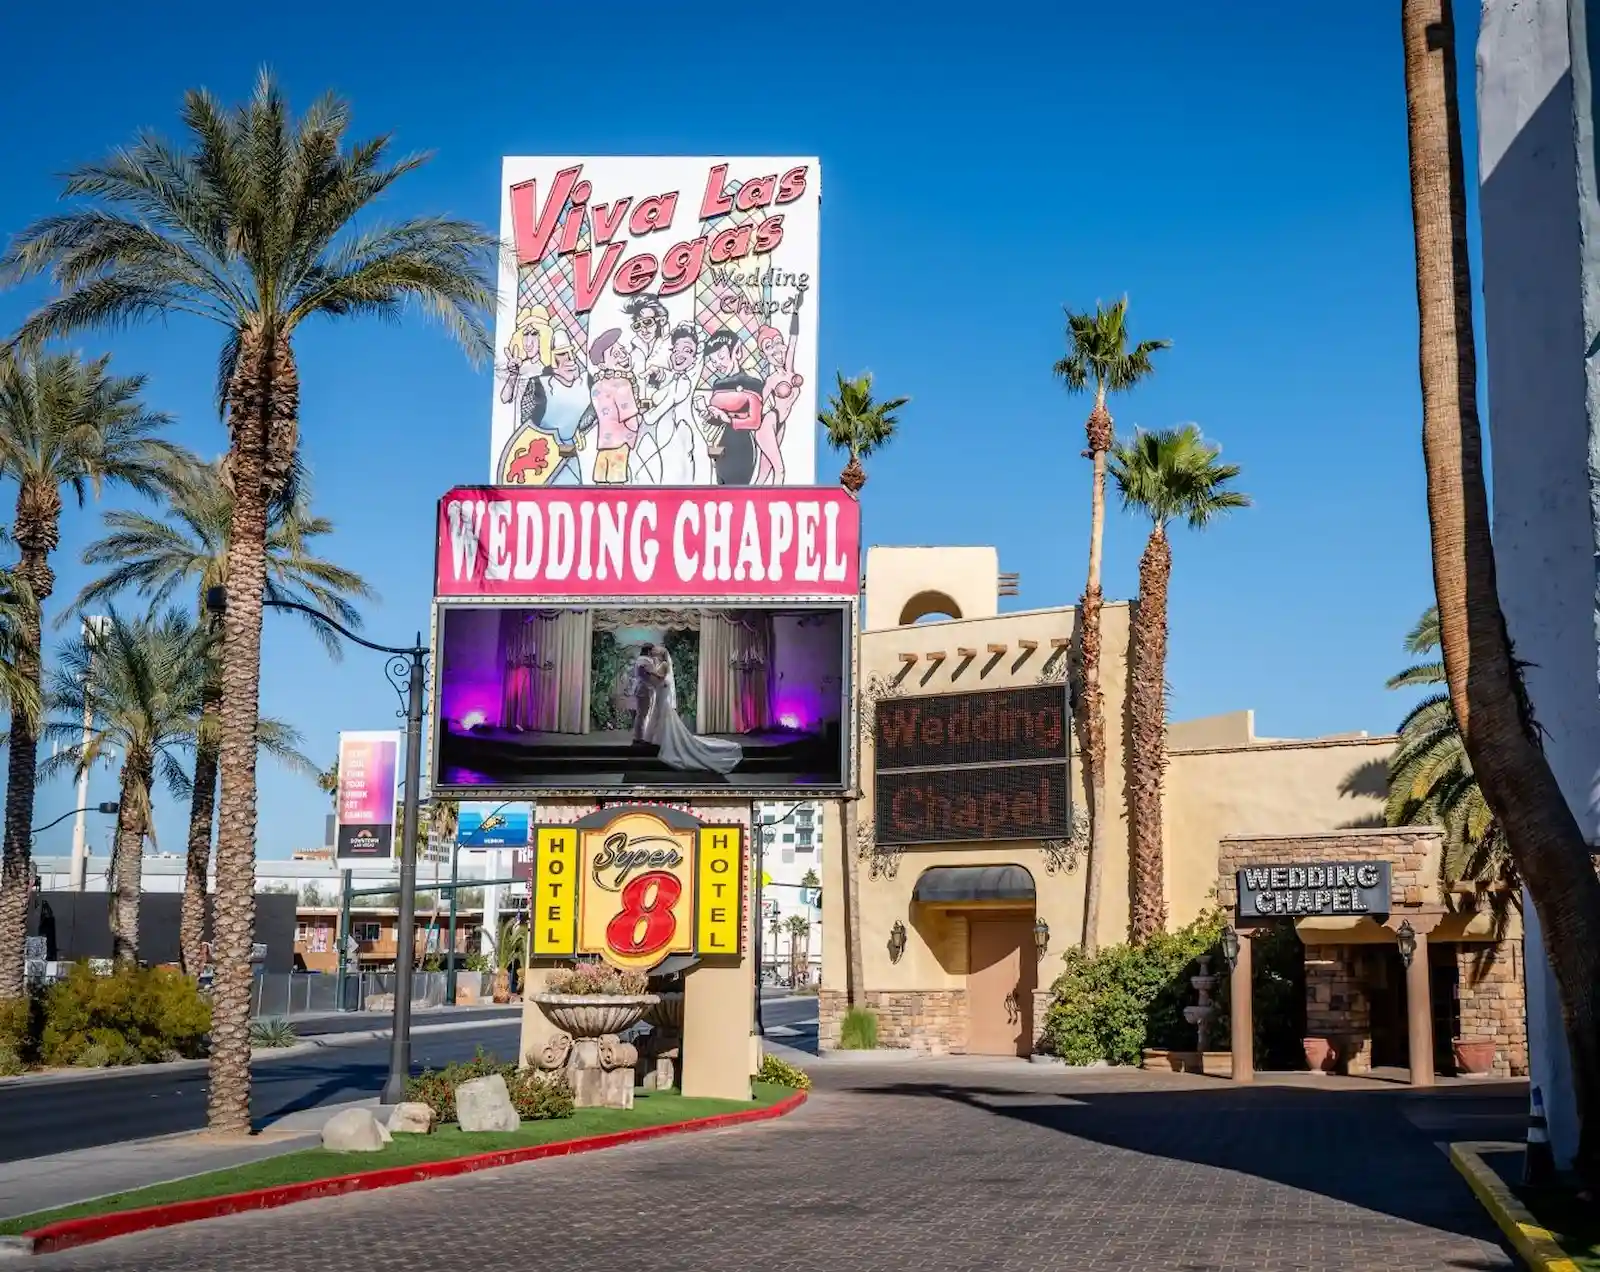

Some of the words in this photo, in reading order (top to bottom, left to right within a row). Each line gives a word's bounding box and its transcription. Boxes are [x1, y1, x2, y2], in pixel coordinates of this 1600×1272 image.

[509, 164, 680, 265] Viva
[699, 163, 809, 222] Las
[573, 214, 786, 315] Vegas
[711, 266, 810, 292] Wedding
[720, 293, 802, 318] Chapel
[447, 500, 660, 582] WEDDING
[672, 499, 848, 582] CHAPEL
[879, 698, 1062, 748] Wedding
[892, 776, 1050, 839] Chapel
[547, 838, 564, 944] HOTEL
[592, 832, 683, 889] Super
[709, 834, 729, 948] HOTEL
[1245, 865, 1380, 890] WEDDING
[605, 870, 682, 956] 8
[1255, 889, 1368, 914] CHAPEL
